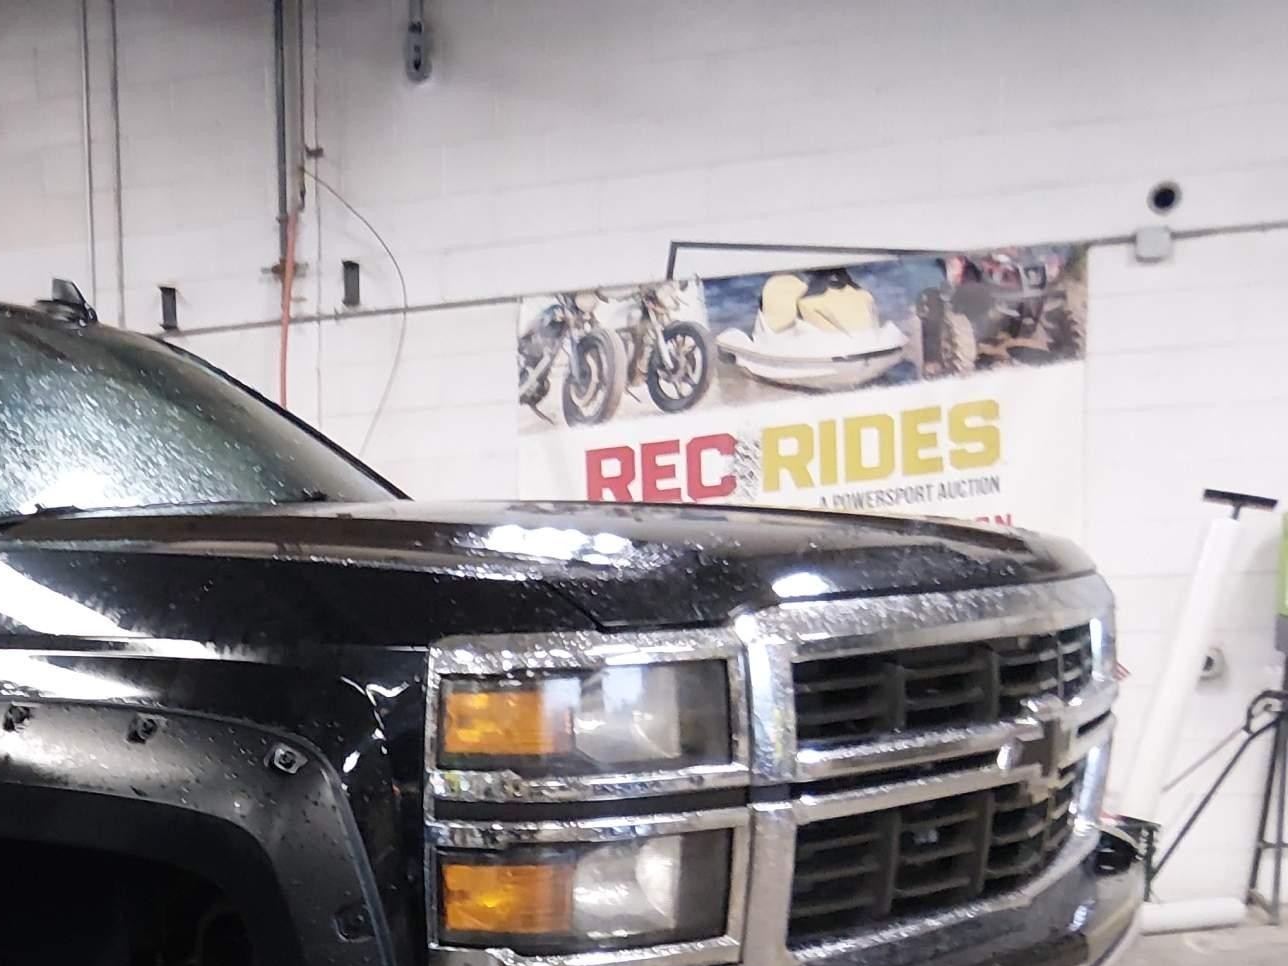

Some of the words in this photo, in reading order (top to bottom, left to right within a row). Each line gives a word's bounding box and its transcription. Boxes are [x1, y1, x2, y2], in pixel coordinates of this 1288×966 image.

[585, 432, 738, 502] REC
[761, 399, 1001, 493] RIDES
[832, 483, 934, 510] POWERSPORT
[937, 475, 1001, 499] AUCTION
